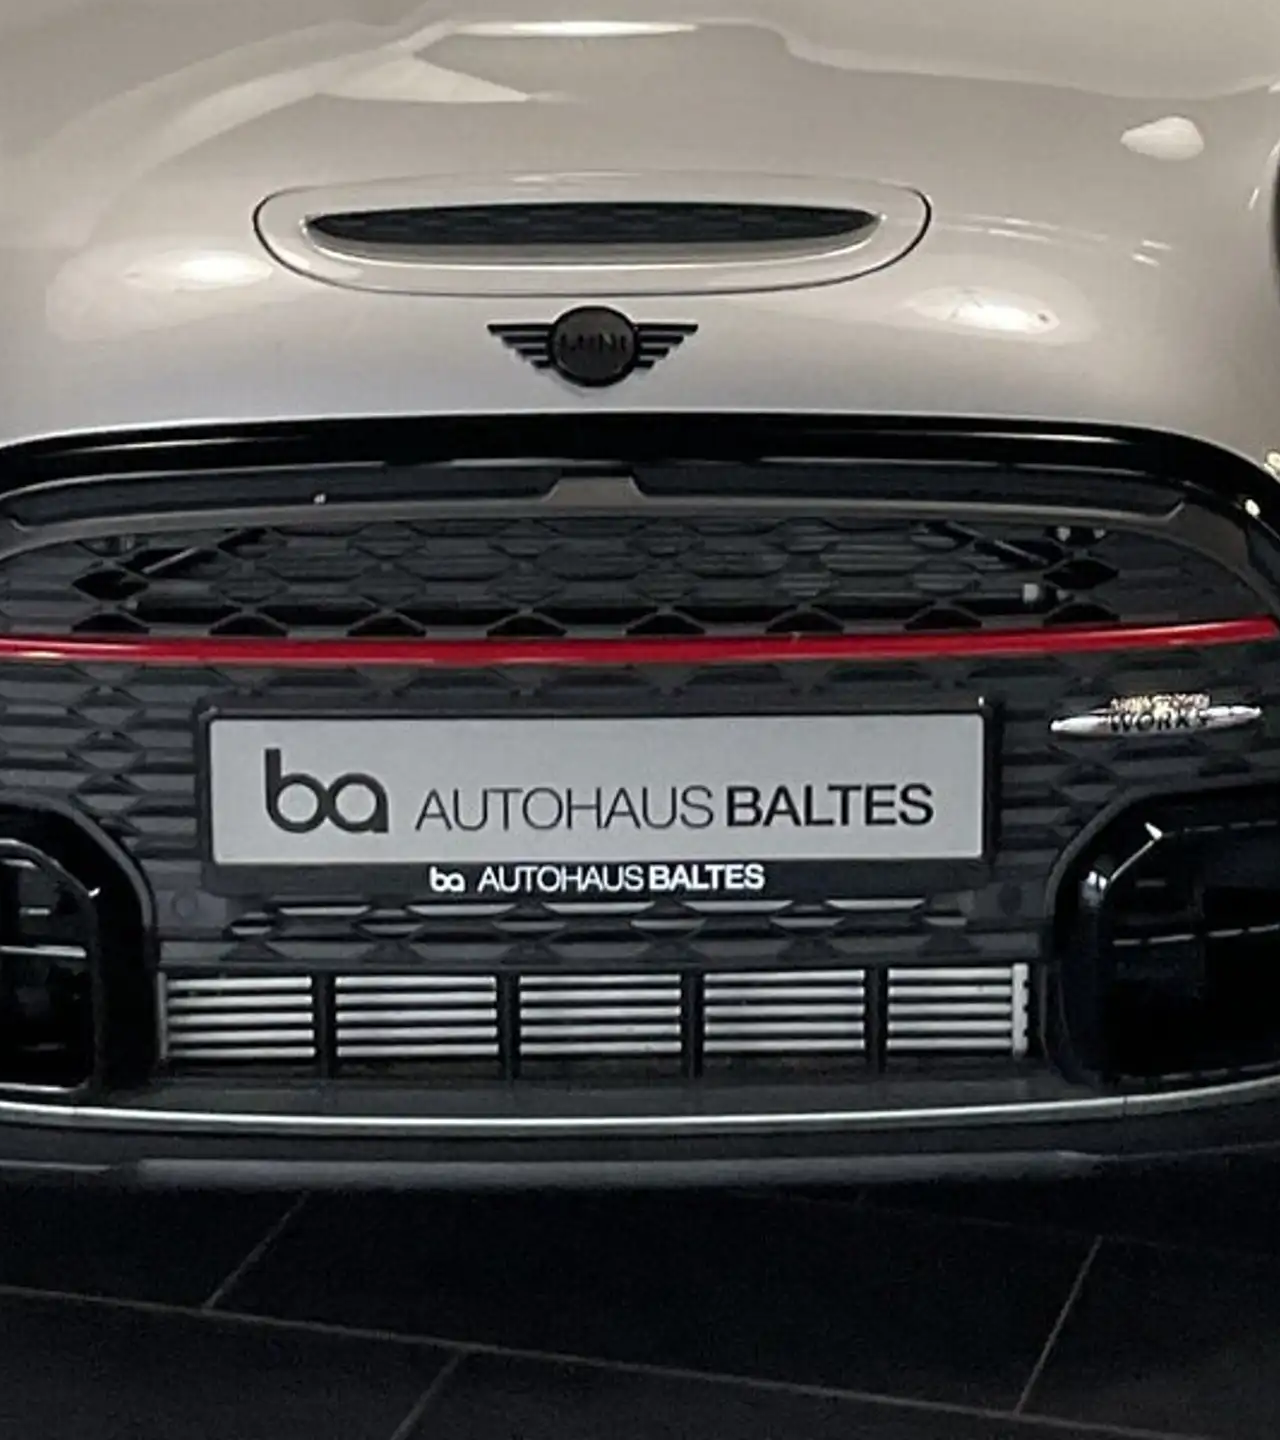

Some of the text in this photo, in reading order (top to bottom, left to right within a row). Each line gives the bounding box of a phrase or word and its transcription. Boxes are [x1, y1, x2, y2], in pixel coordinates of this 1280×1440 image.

[265, 747, 934, 834] ba AUTOHAUS BALTES
[429, 863, 765, 893] ba AUTOHAUS BALTES
